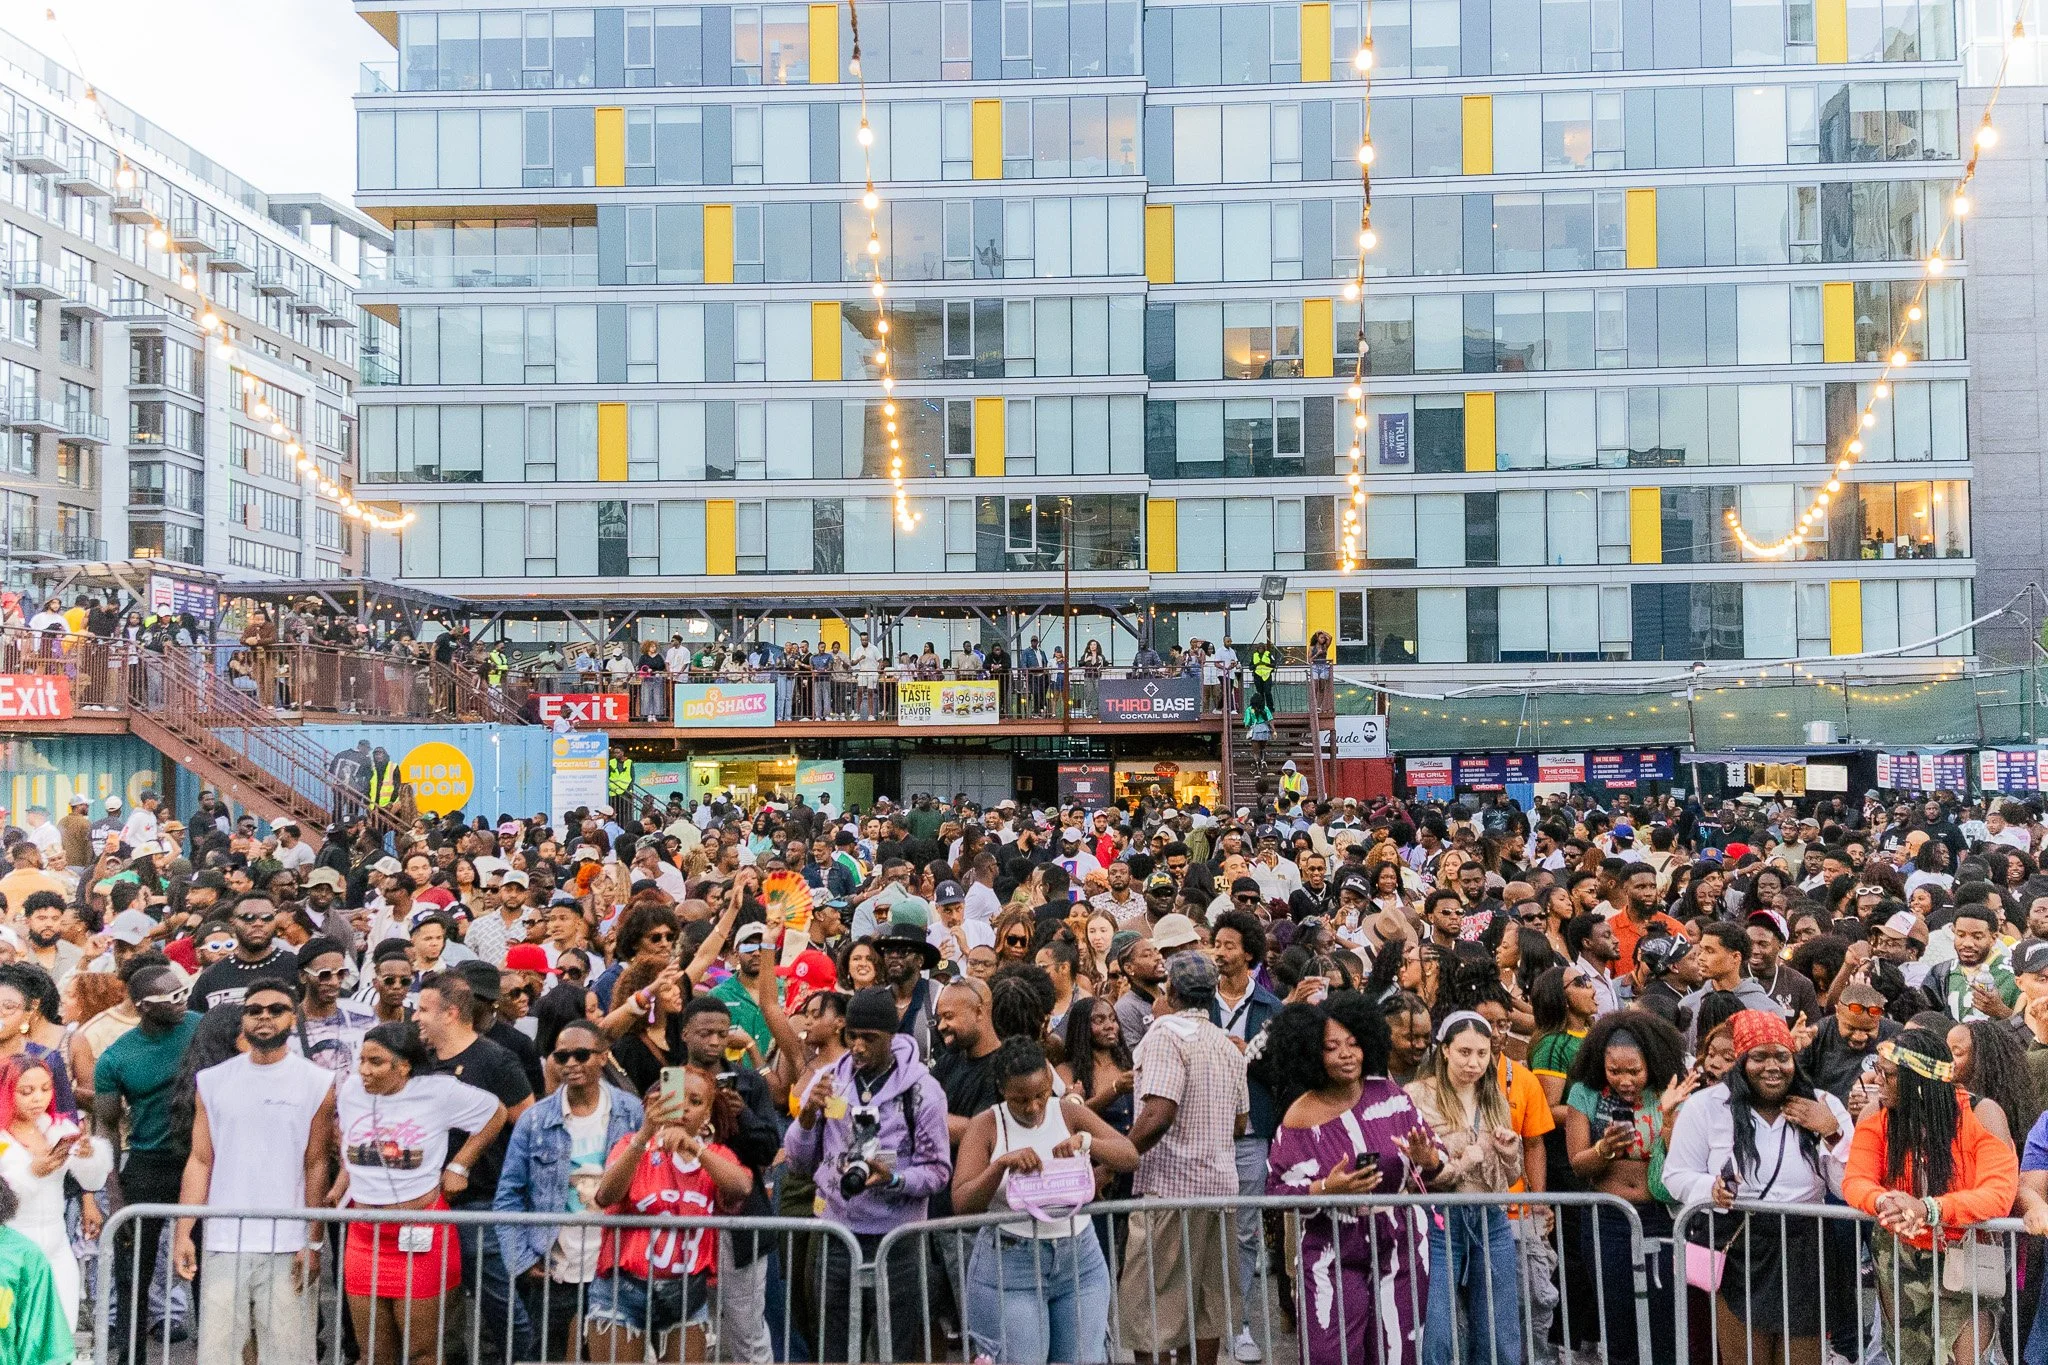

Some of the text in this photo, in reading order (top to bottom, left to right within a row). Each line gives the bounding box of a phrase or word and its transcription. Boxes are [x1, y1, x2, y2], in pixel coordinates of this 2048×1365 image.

[1395, 419, 1405, 458] TRUMP
[0, 677, 61, 716] Exit
[900, 689, 931, 703] TASTE
[539, 695, 618, 721] Exit
[687, 696, 763, 717] DAQ SHACK
[900, 707, 931, 716] FLAVOR
[1105, 697, 1195, 712] THIRD BASE
[410, 764, 461, 779] HIGH
[814, 773, 834, 782] SHACK
[1142, 775, 1160, 783] pepsi
[655, 775, 678, 784] SHACK
